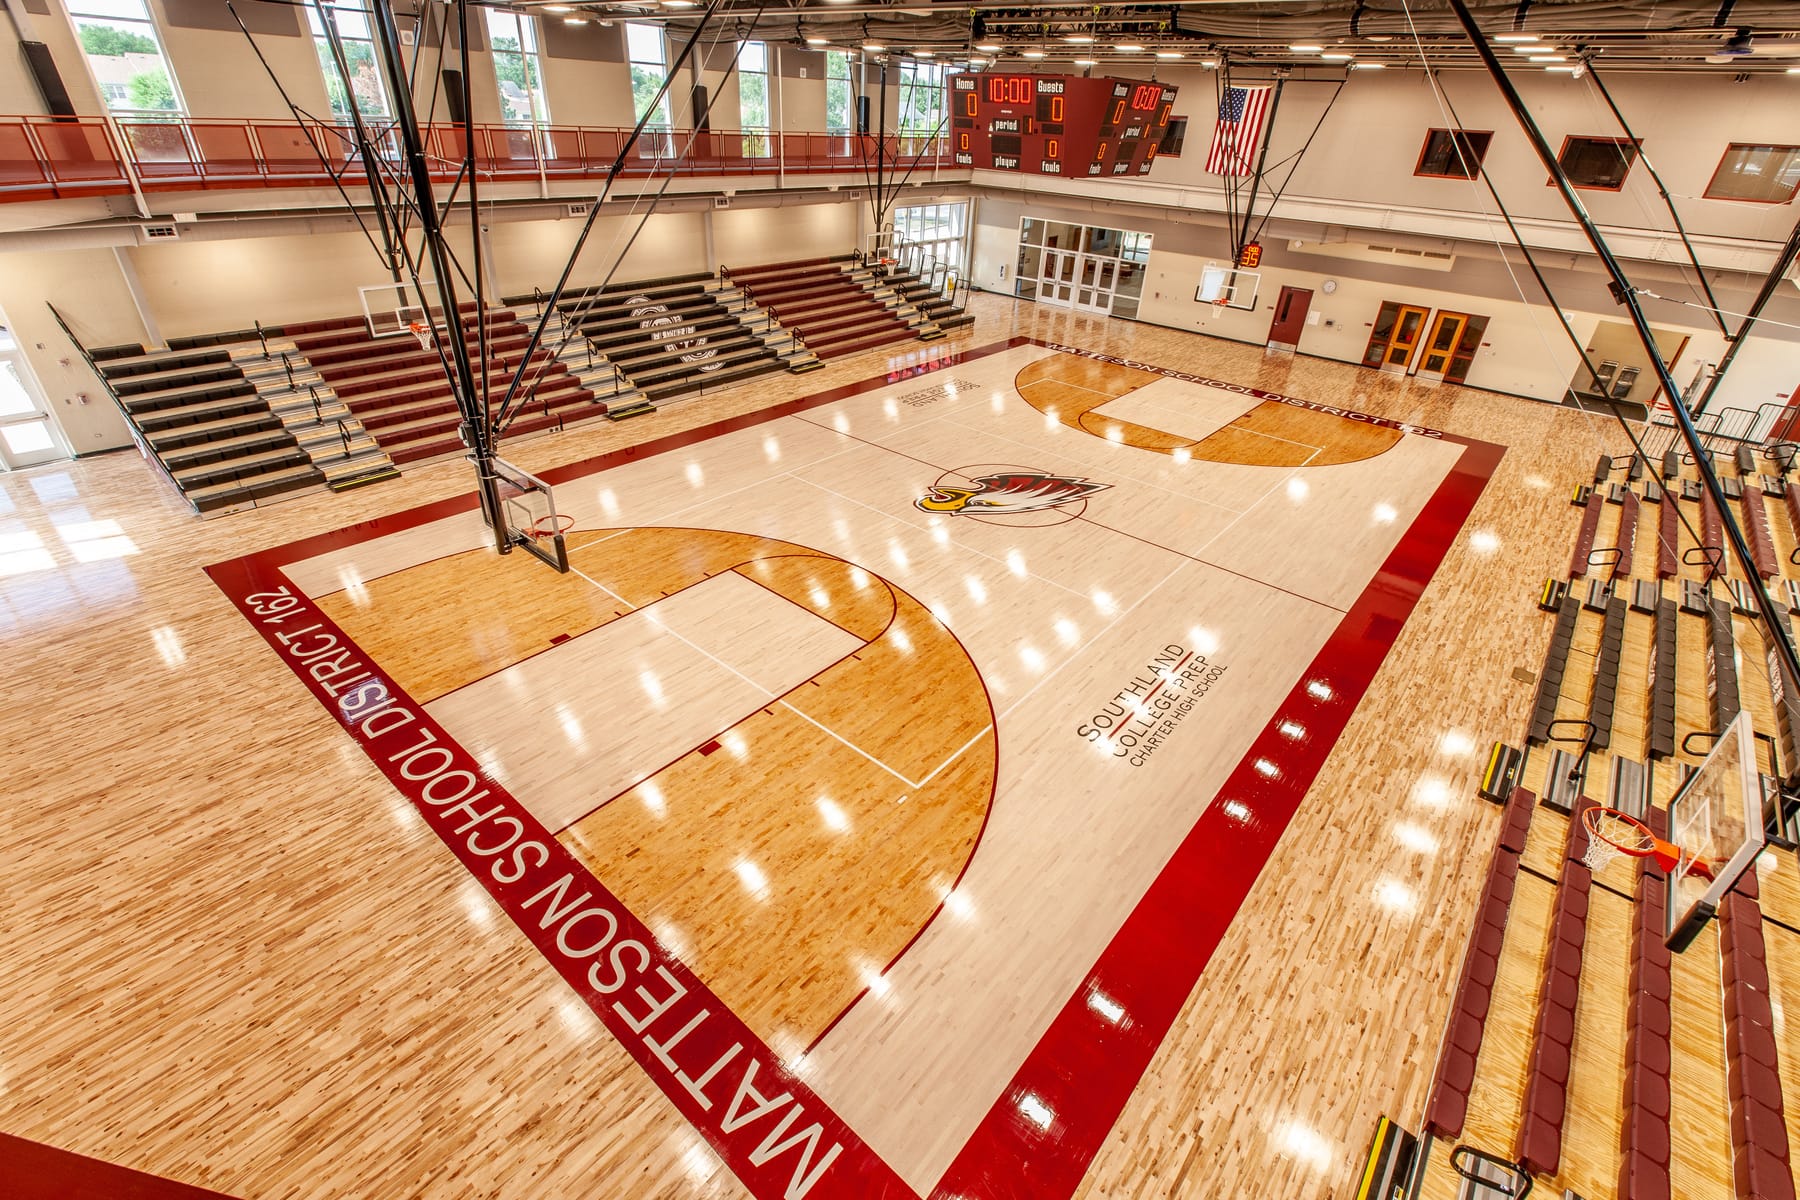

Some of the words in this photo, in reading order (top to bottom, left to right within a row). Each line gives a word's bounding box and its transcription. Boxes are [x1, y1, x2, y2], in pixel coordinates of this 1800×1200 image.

[956, 78, 974, 90] Home
[989, 78, 1031, 103] 10:00
[1037, 80, 1063, 93] Guests
[967, 93, 977, 116] 0
[1052, 97, 1063, 121] 0
[1132, 85, 1161, 111] 10:00
[1112, 100, 1126, 124] 0
[1160, 104, 1171, 126] 0
[995, 119, 1017, 131] period
[1125, 126, 1141, 138] period
[961, 134, 969, 150] 0
[1049, 140, 1058, 157] 0
[1097, 143, 1106, 160] 0
[1147, 143, 1157, 159] 0
[956, 153, 972, 164] fouls
[995, 156, 1017, 168] player
[1041, 161, 1060, 173] fouls
[1241, 251, 1259, 266] 35
[1048, 343, 1158, 372] MATTESON
[1160, 369, 1256, 396] SCHOOL
[1262, 392, 1388, 425] DISTRICT
[1395, 423, 1443, 438] 162
[244, 585, 307, 624] 162
[274, 623, 417, 740] DISTRICT
[1077, 644, 1185, 742] SOUTHLAND
[1113, 689, 1181, 758] COLLEGE
[1173, 655, 1209, 690] PREP
[1129, 719, 1178, 767] CHARTER
[1171, 696, 1198, 721] HIGH
[1191, 664, 1228, 698] SCHOOL
[388, 727, 550, 884] SCHOOL
[521, 873, 845, 1200] MATTESON
